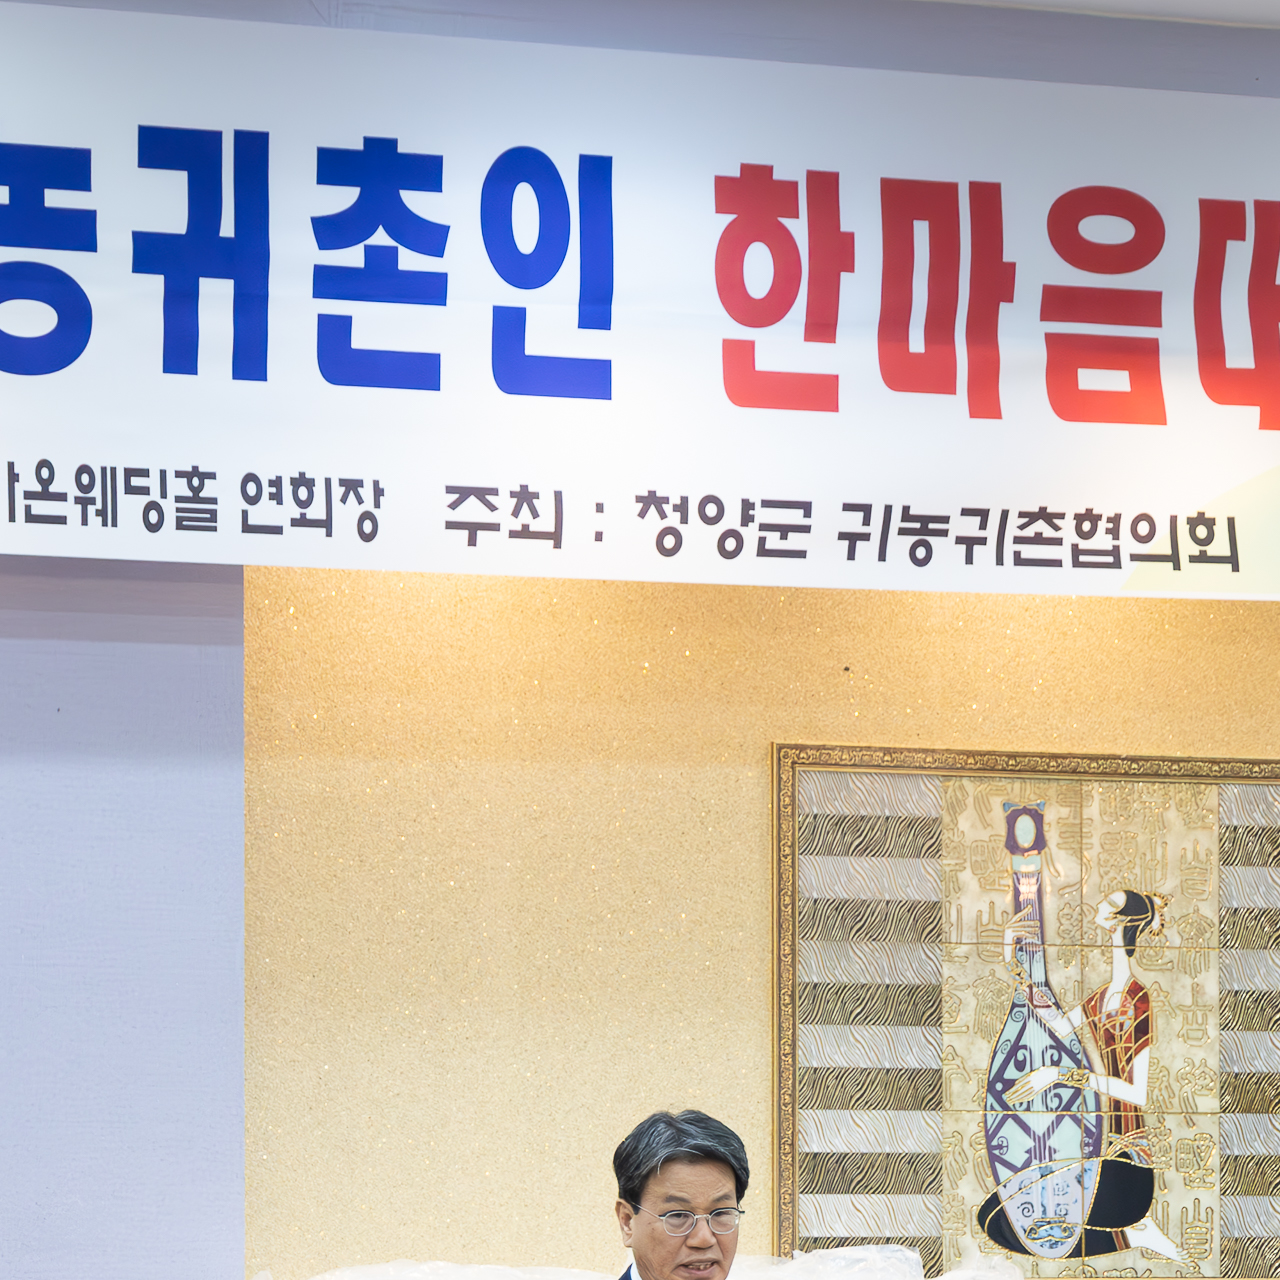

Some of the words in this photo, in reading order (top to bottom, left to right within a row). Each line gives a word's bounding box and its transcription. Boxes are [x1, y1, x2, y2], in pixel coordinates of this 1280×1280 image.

[240, 471, 385, 543] 연회장
[445, 484, 563, 549] 주최
[635, 490, 813, 560] 청양군
[837, 502, 1240, 573] 귀농귀촌협의회
